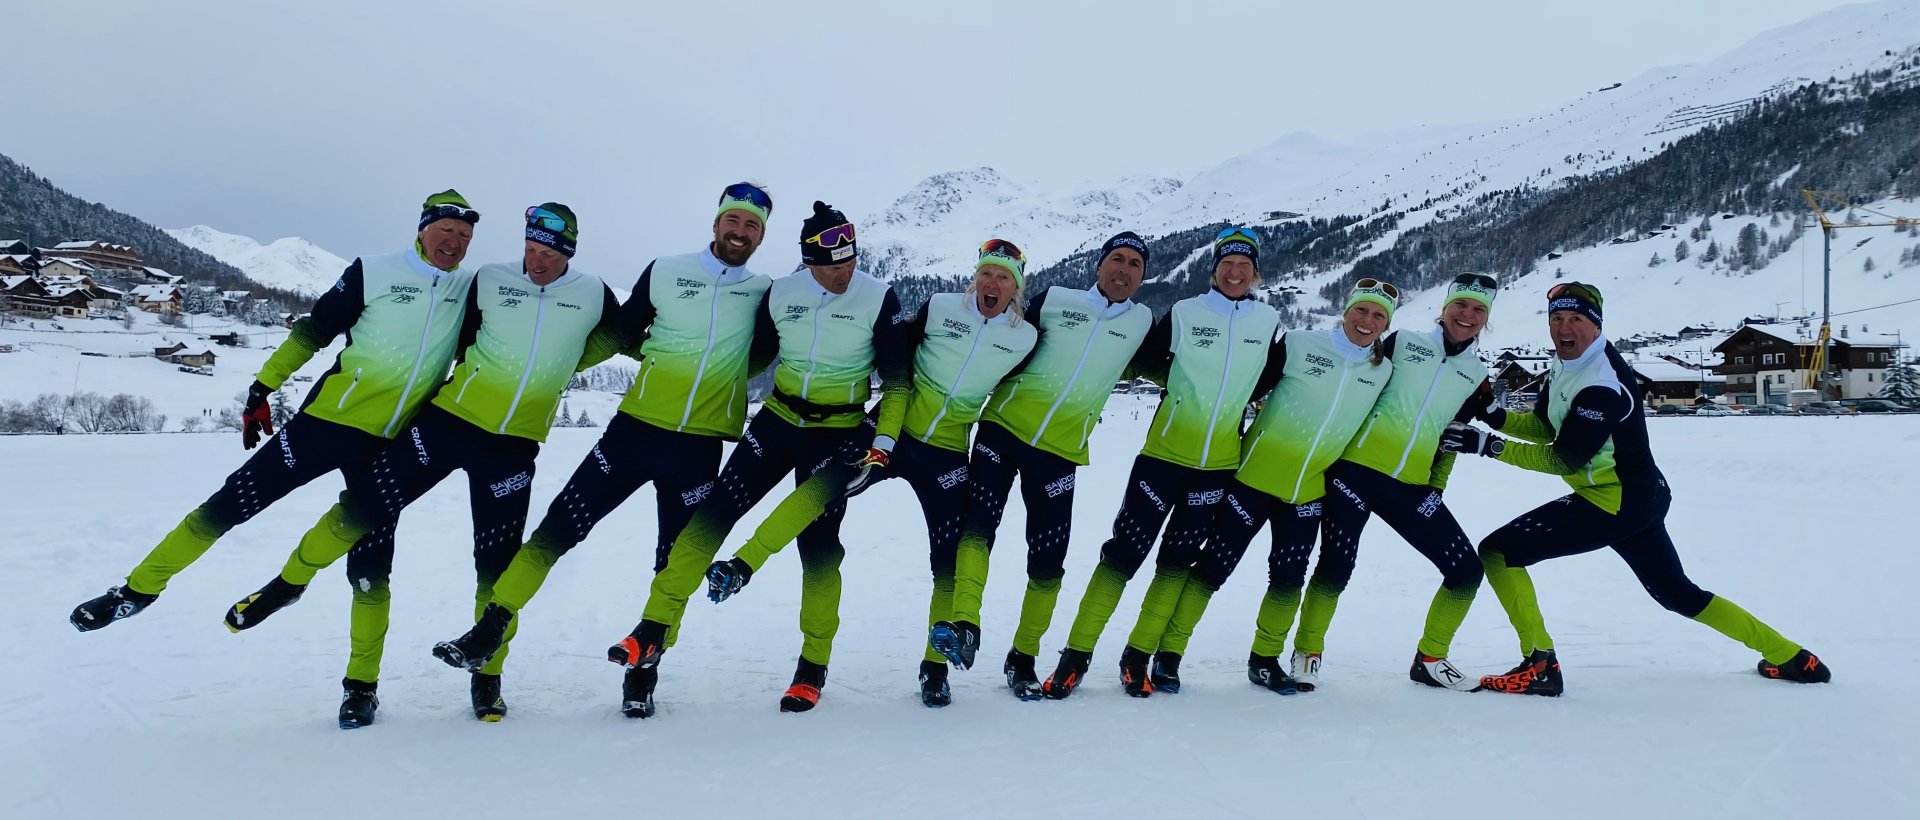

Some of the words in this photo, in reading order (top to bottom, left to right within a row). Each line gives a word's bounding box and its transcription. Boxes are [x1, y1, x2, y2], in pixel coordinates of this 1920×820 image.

[557, 302, 577, 310] CRAFT
[411, 426, 428, 457] CRAFT
[976, 443, 996, 457] CRAFT
[490, 470, 528, 491] SANDOZ
[1333, 478, 1362, 504] CRAFT
[1139, 480, 1164, 506] CRAFT
[1188, 488, 1223, 500] SANDOZ
[1227, 494, 1251, 520] CRAFT
